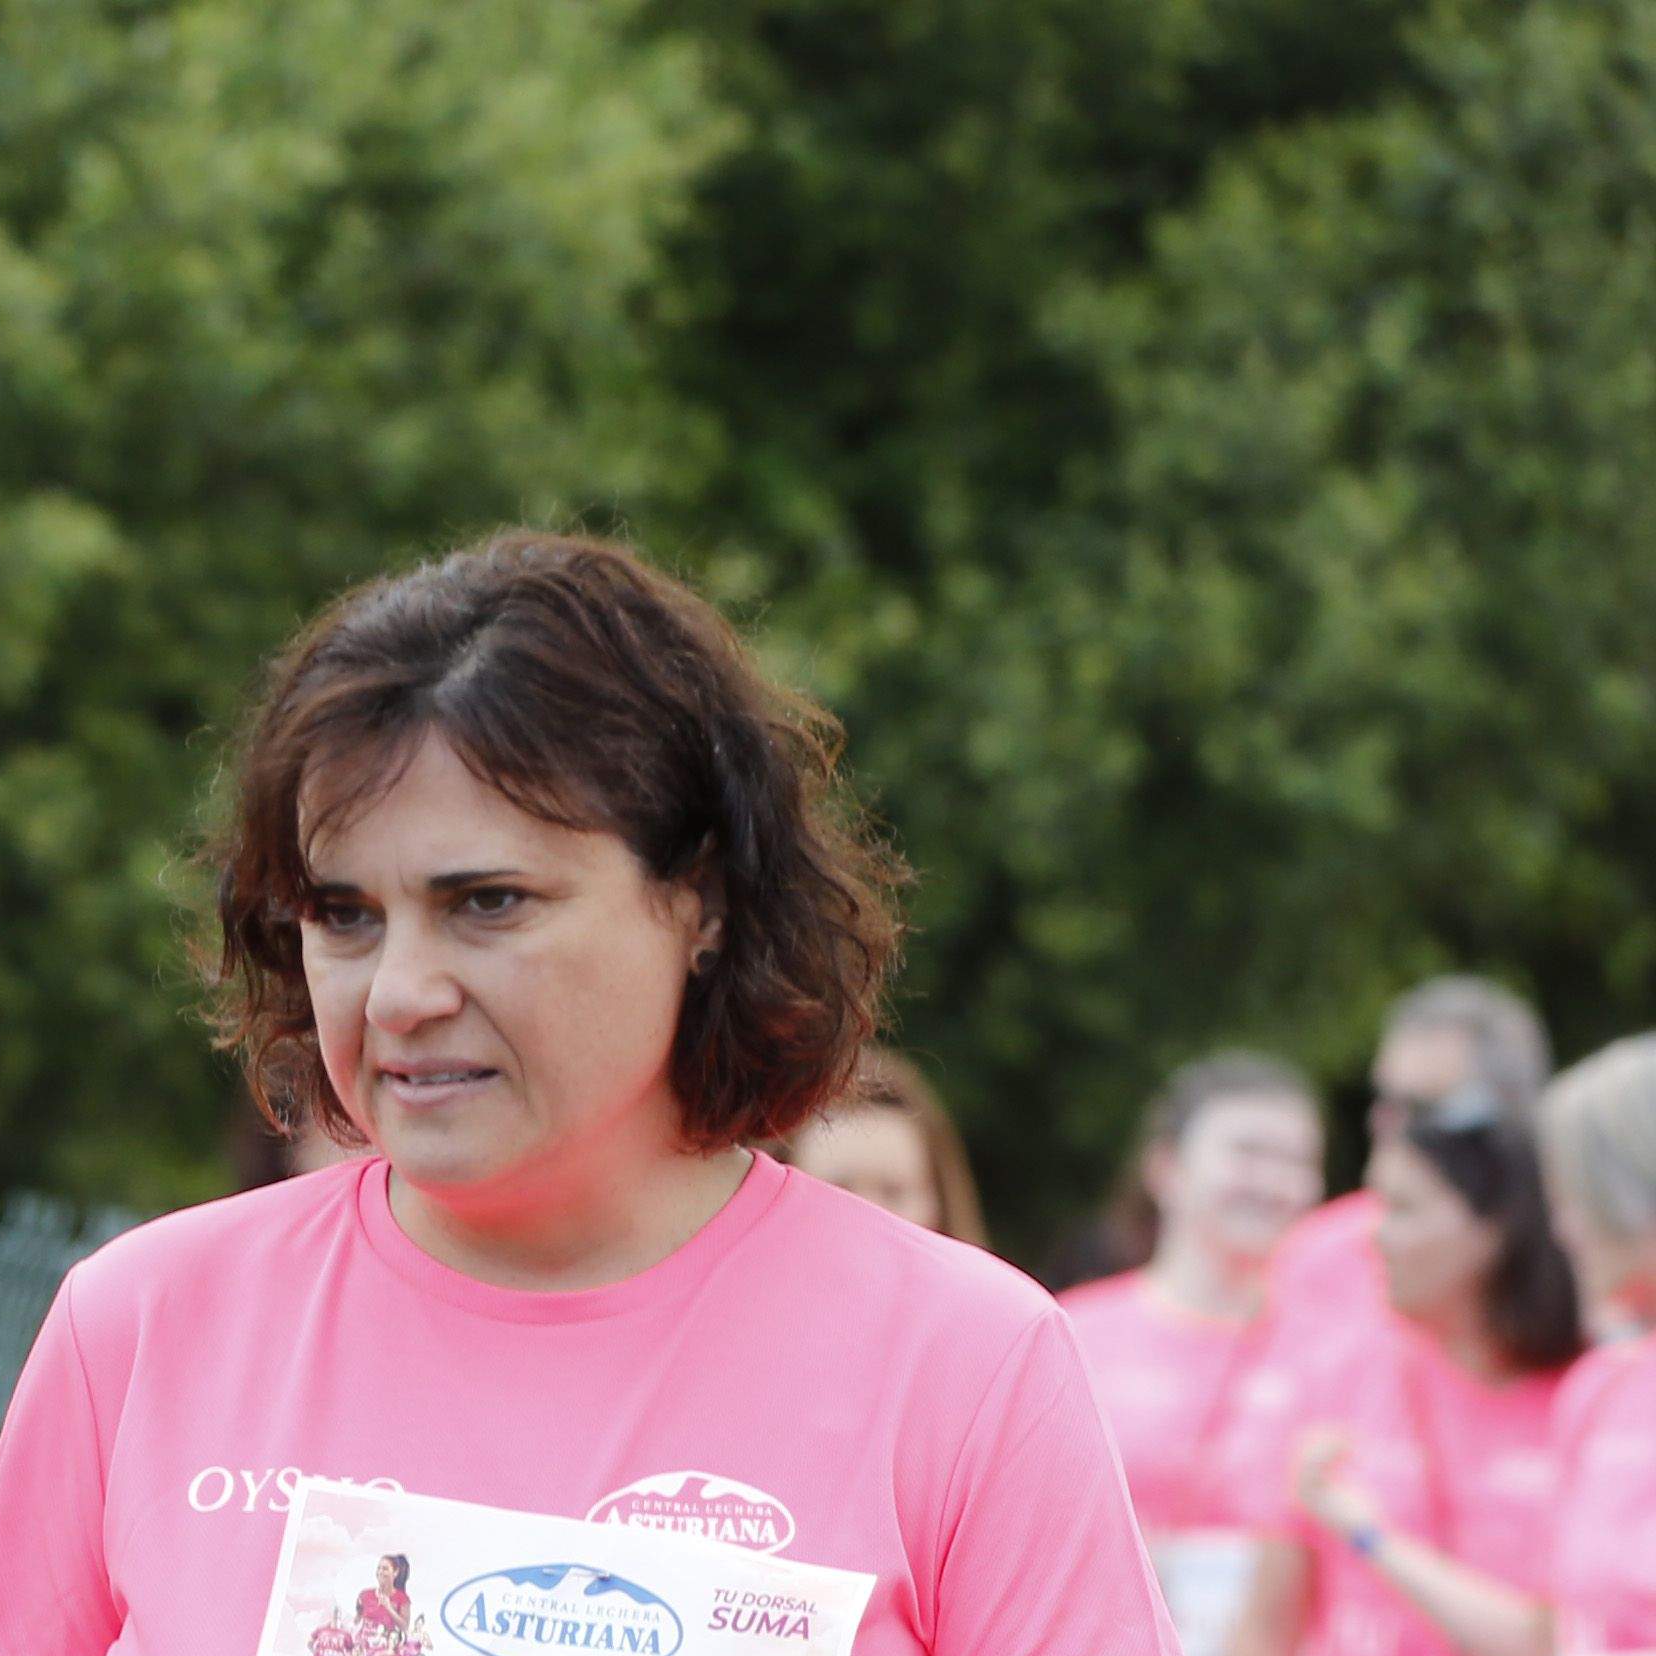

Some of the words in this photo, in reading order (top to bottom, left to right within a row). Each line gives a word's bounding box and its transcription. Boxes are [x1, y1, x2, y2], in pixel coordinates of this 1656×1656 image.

[502, 1592, 578, 1614] CENTRAL
[586, 1604, 661, 1623] LECHERA
[713, 1588, 736, 1603] TU
[741, 1592, 818, 1615] DORSAL
[457, 1592, 661, 1655] ASTURIANA
[707, 1606, 810, 1640] SUMA
